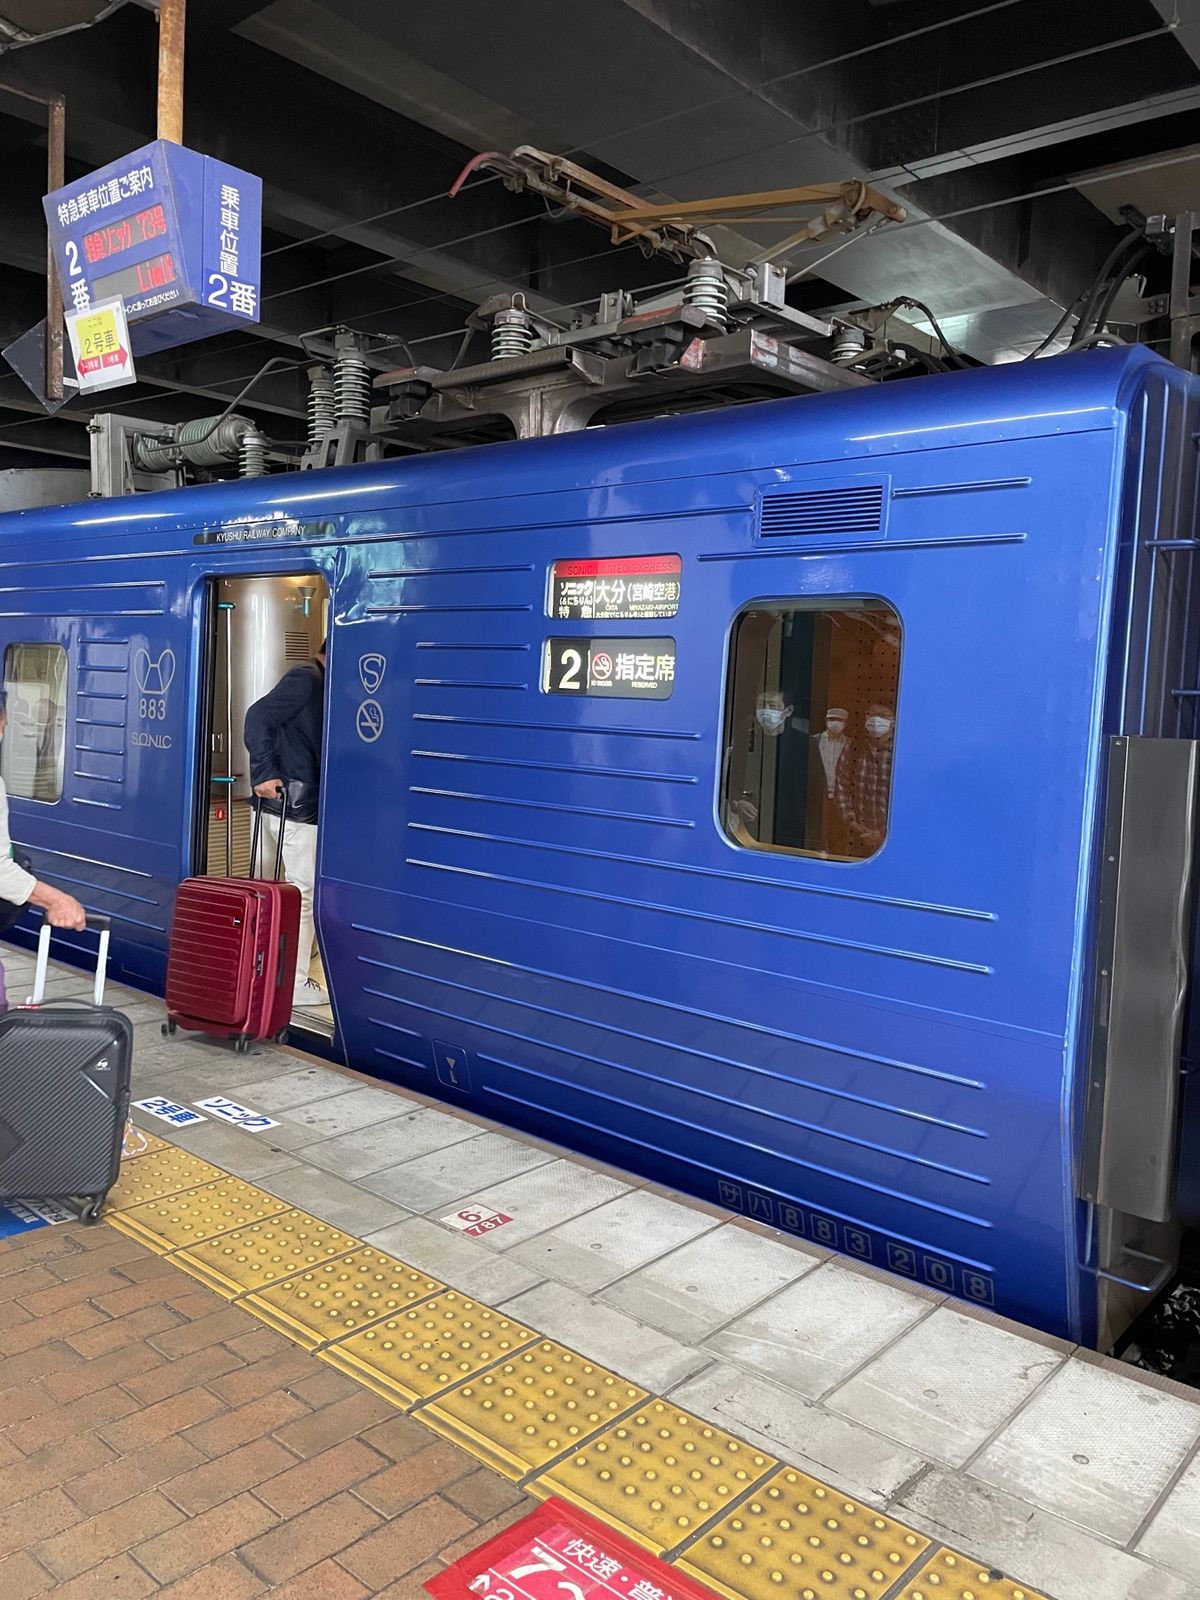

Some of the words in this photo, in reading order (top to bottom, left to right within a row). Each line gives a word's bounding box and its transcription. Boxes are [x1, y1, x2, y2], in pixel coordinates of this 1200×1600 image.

[57, 165, 154, 227] 特急乗車位置ご案内
[136, 205, 167, 240] 73号
[219, 184, 240, 278] 乗車位置
[208, 274, 257, 317] 2番
[84, 329, 116, 355] 2号車
[215, 529, 242, 542] KYUSHU
[243, 527, 271, 540] RAILWAY
[272, 525, 306, 538] COMPANY
[567, 566, 593, 576] SONIC
[596, 564, 629, 574] LIMITED
[633, 561, 674, 572] EXPRESS
[560, 580, 594, 596] ソニック
[559, 648, 582, 690] 2
[615, 653, 675, 682] 指定席
[139, 697, 166, 721] 883
[130, 731, 172, 749] SONIC
[142, 1099, 200, 1123] 2号車
[204, 1098, 272, 1126] ソニック
[457, 1210, 482, 1222] 6
[468, 1216, 505, 1234] 787
